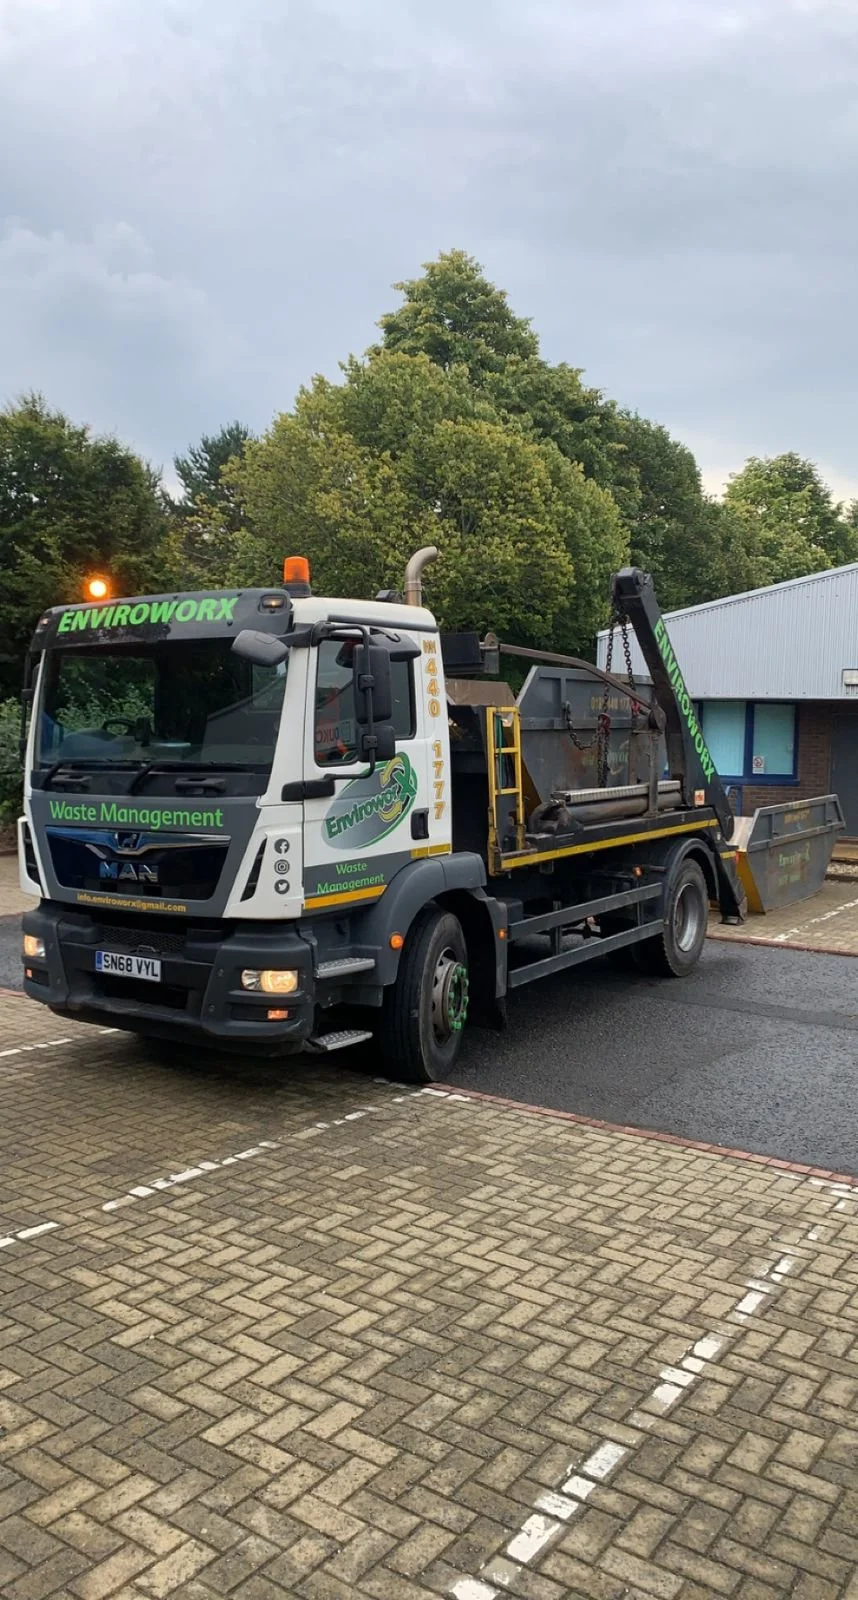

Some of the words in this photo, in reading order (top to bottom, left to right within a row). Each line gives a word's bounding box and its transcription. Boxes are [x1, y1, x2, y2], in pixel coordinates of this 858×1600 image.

[57, 598, 238, 633] ENVIROWORX
[425, 657, 441, 718] 440
[654, 618, 714, 784] ENVIROWORX
[431, 739, 446, 820] 1777
[50, 801, 97, 821] Waste
[100, 803, 224, 830] Management
[100, 862, 159, 882] MAN
[335, 862, 368, 875] Waste
[316, 874, 385, 894] Management
[103, 953, 133, 973] SN68
[136, 958, 159, 978] VYL
